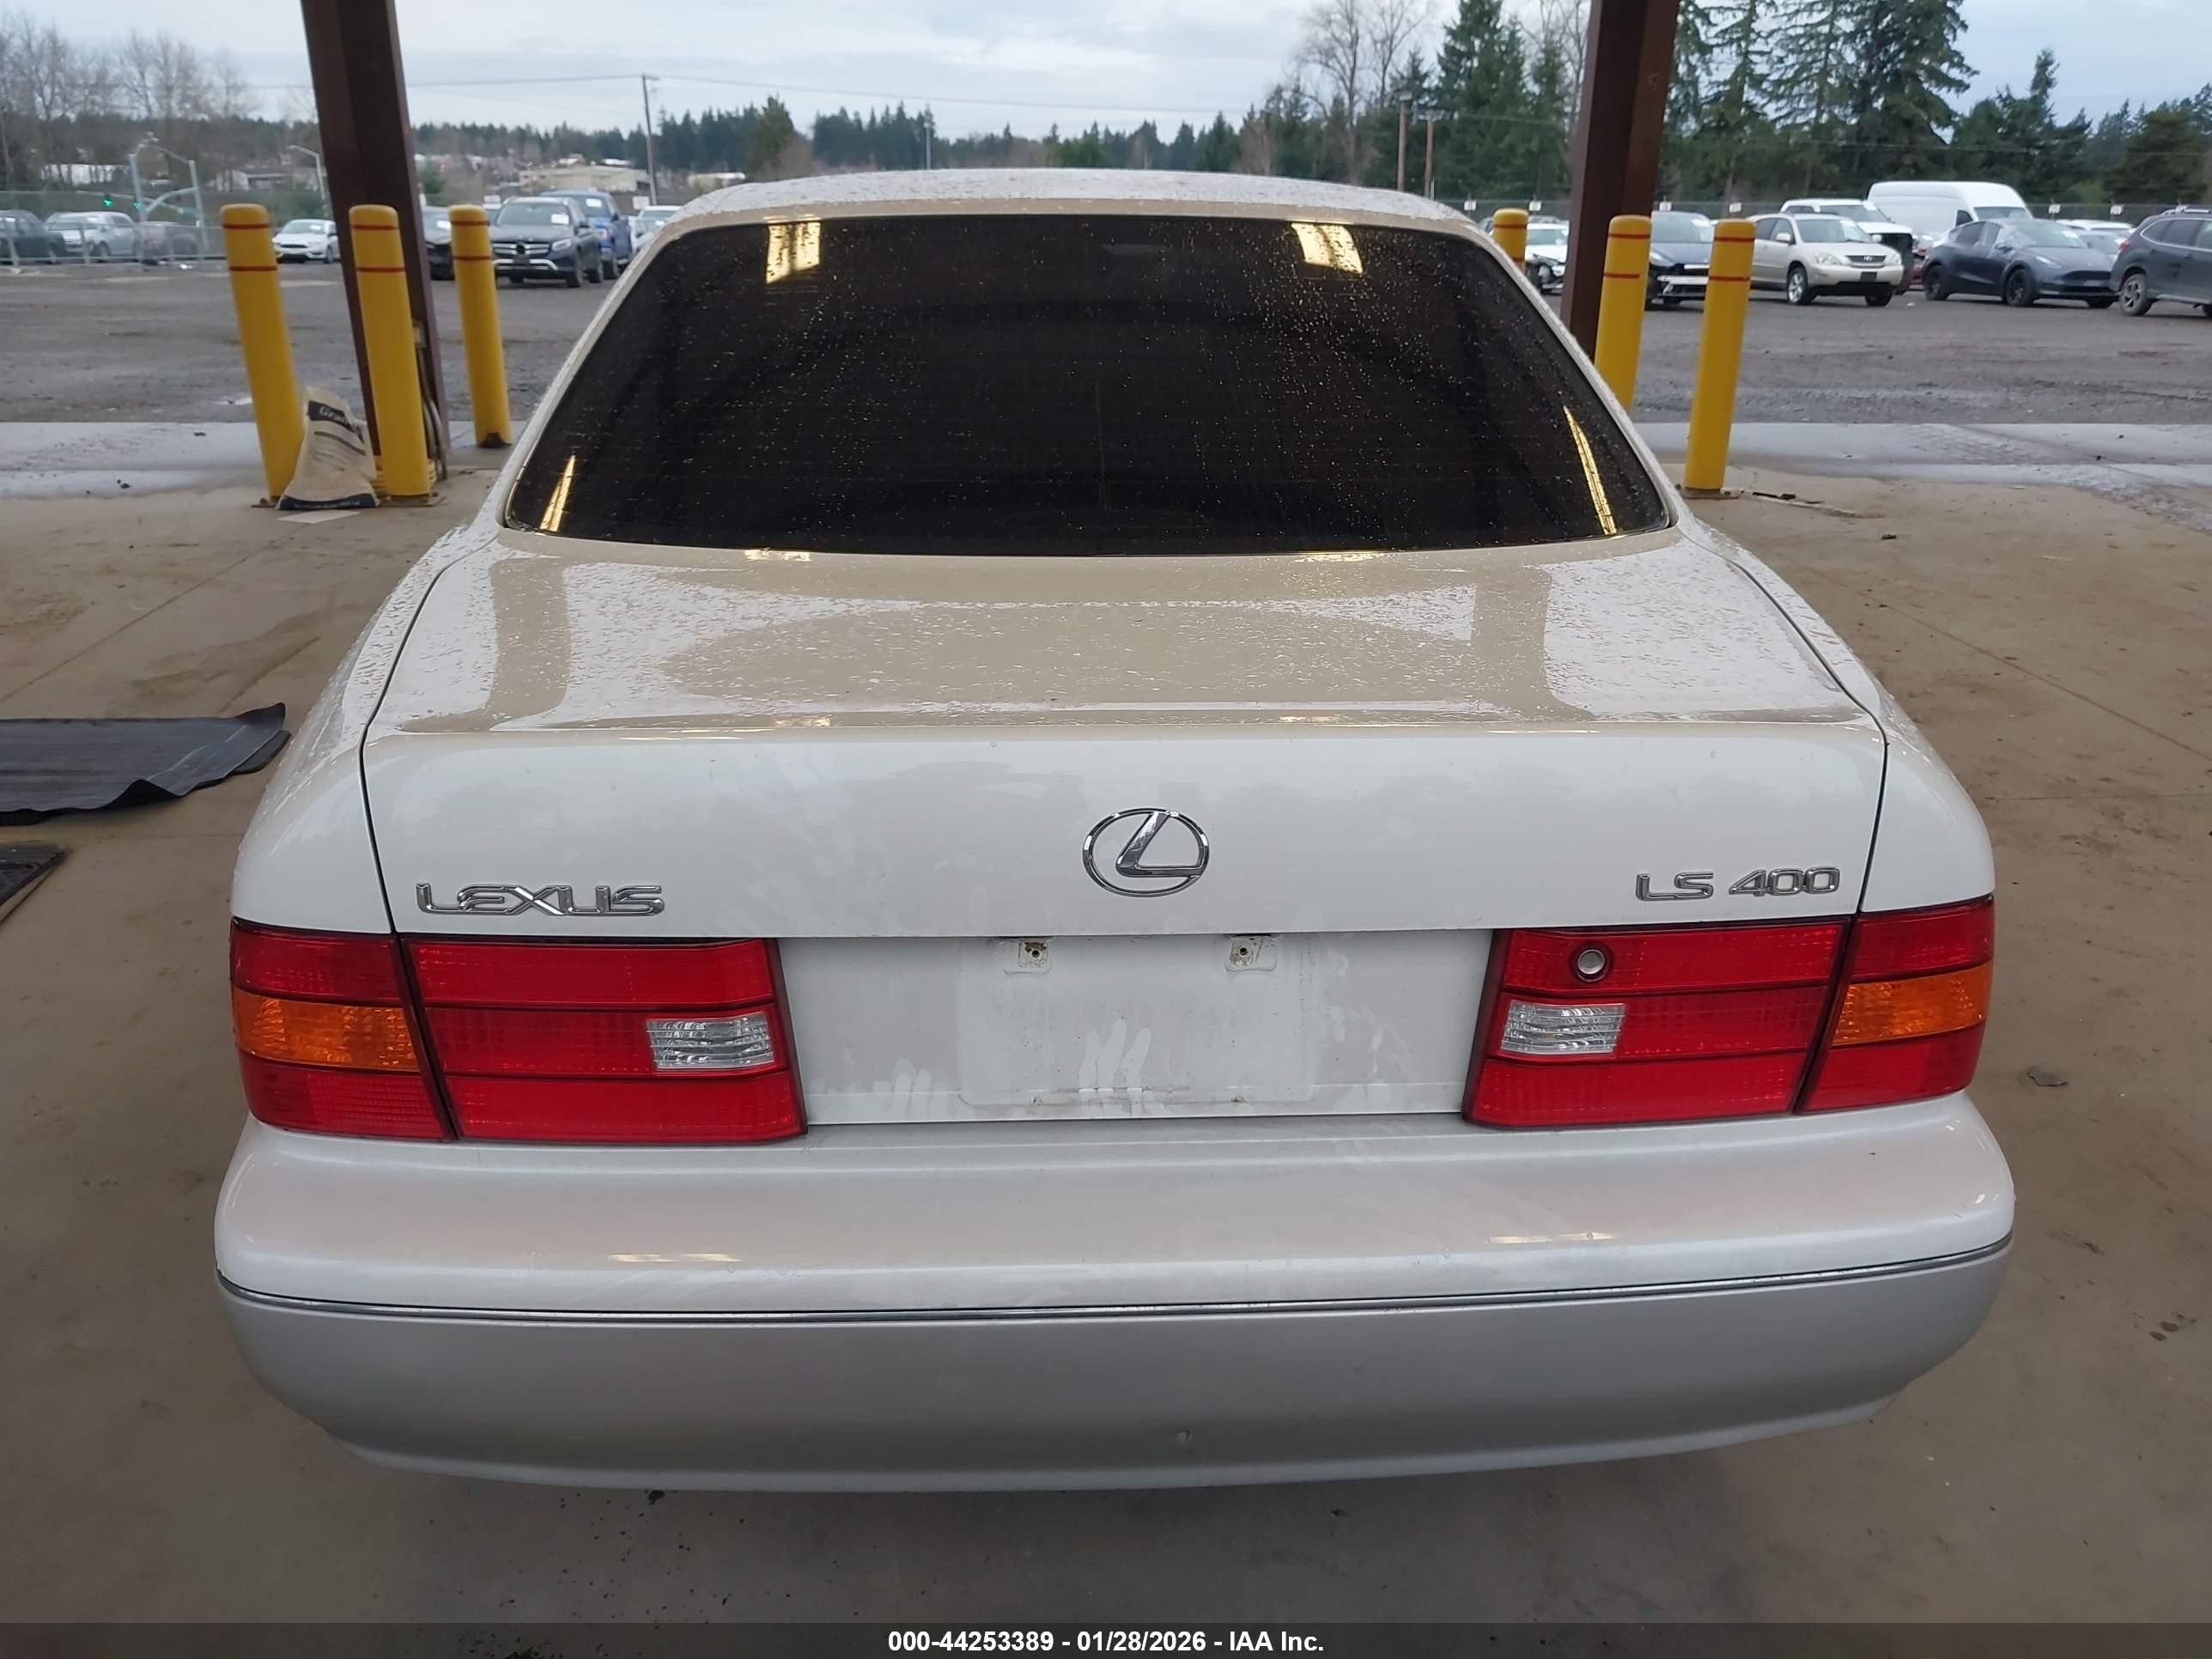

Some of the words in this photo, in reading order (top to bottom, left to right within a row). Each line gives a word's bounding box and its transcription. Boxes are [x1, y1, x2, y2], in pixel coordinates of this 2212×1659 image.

[416, 883, 665, 915] LEXUS
[1636, 873, 1714, 902] LS
[1729, 866, 1840, 897] 400
